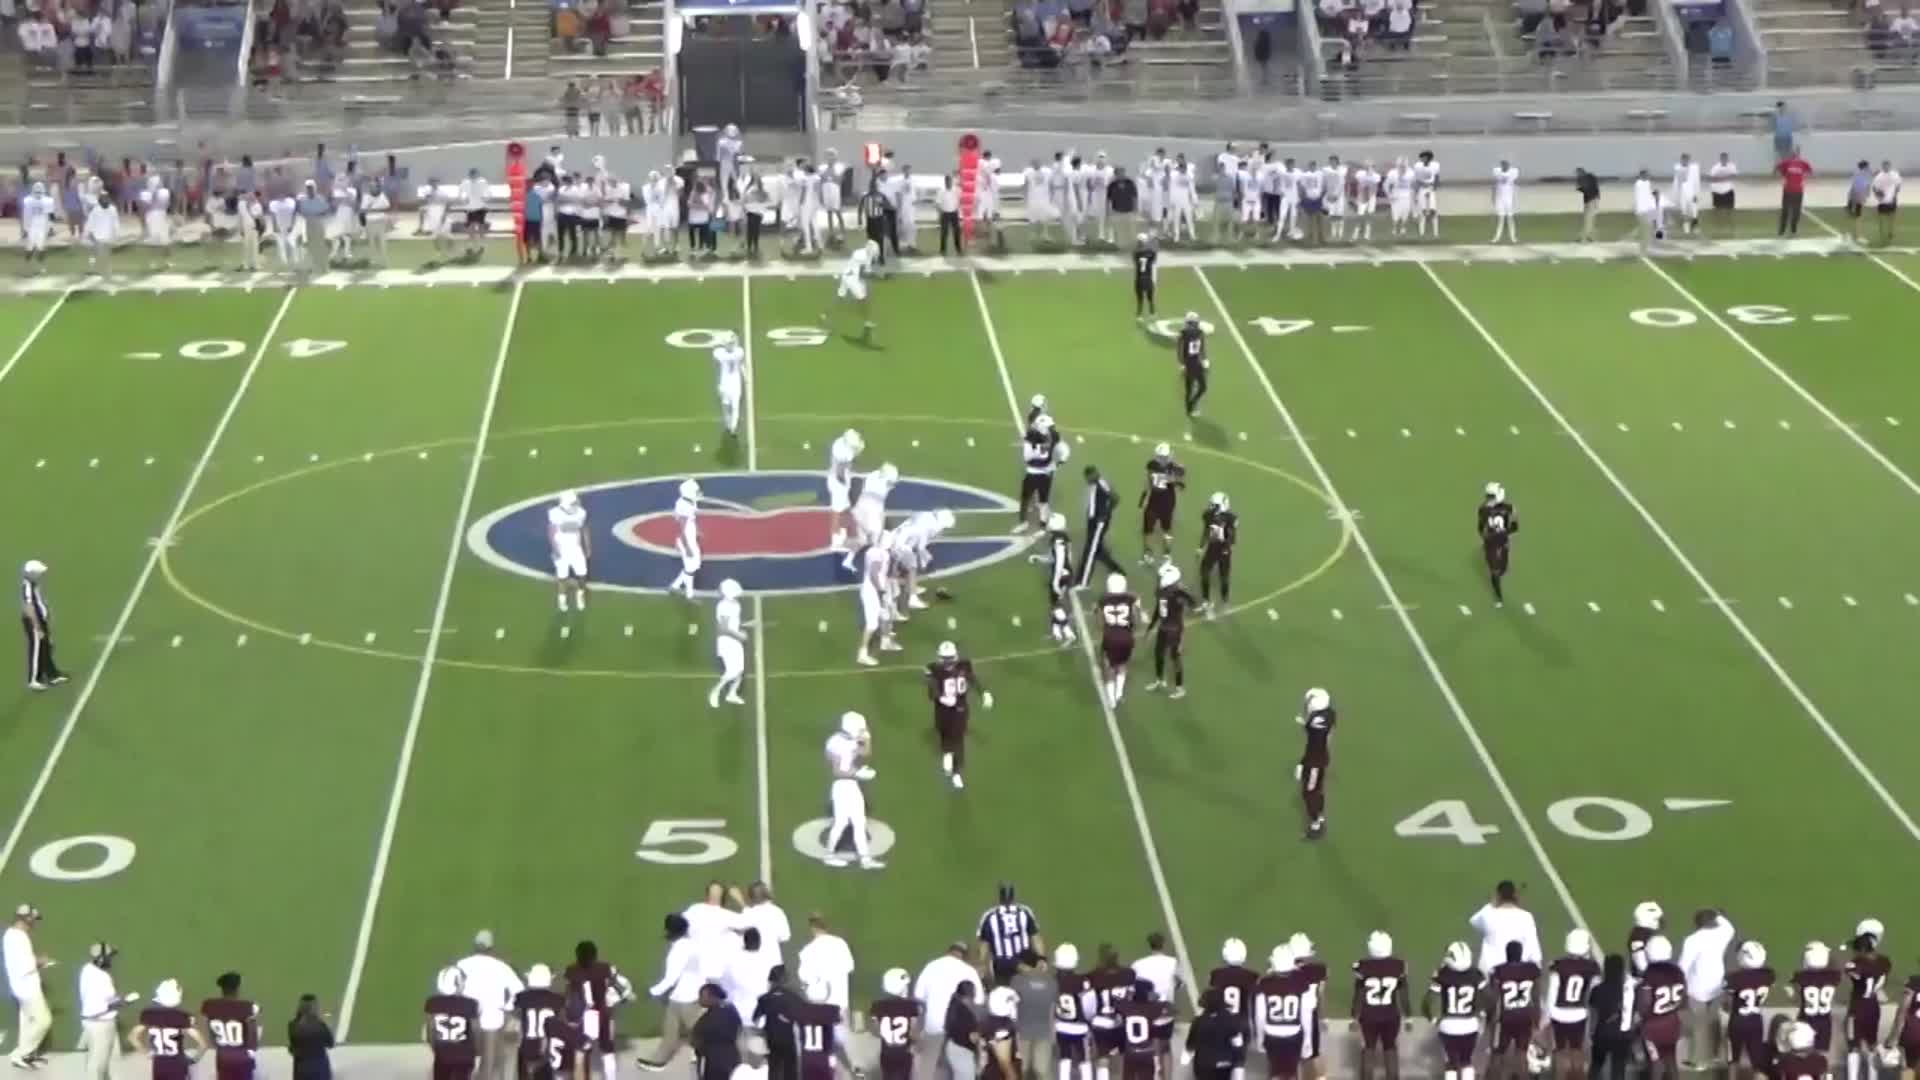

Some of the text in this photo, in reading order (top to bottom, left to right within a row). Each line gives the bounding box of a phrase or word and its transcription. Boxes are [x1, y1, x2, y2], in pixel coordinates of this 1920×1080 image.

[1364, 977, 1398, 1006] 27
[1446, 986, 1474, 1014] 12
[1502, 981, 1534, 1009] 23
[1565, 974, 1583, 1002] 0
[1803, 985, 1835, 1017] 99
[1268, 995, 1300, 1023] 20
[804, 1024, 823, 1050] 11
[1125, 1015, 1149, 1043] 0
[549, 1037, 565, 1069] 5
